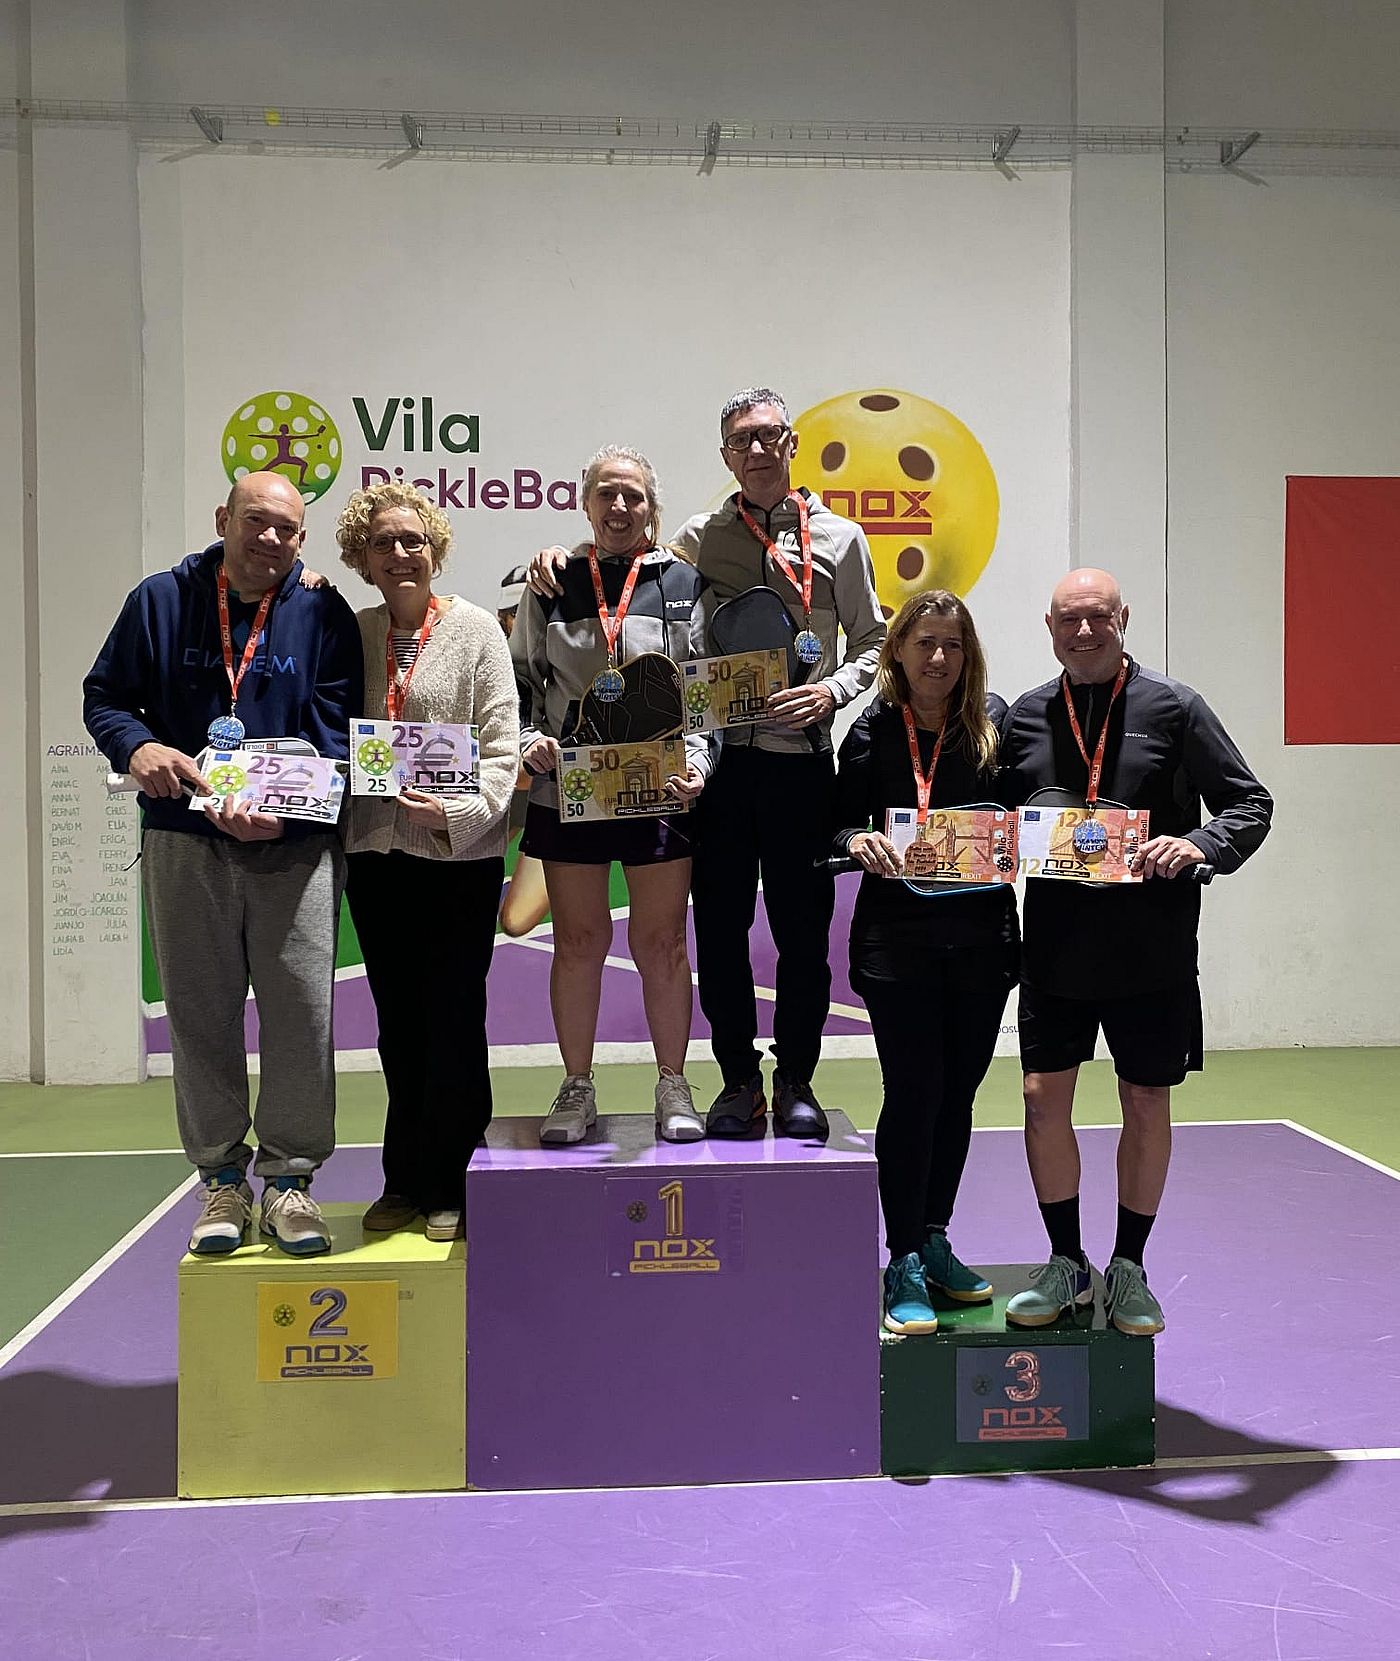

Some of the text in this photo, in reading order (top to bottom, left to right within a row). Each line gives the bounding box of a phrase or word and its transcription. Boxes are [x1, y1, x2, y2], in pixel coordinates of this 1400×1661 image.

[352, 397, 480, 453] Vila
[361, 466, 587, 510] PckleBa
[666, 600, 692, 608] nox
[708, 661, 731, 683] 50
[690, 715, 704, 729] 50
[392, 725, 423, 747] 25
[247, 755, 284, 775] 25
[590, 749, 620, 772] 50
[415, 771, 477, 784] nox
[1091, 764, 1100, 787] nox
[367, 779, 387, 792] 25
[264, 794, 332, 810] nox
[567, 803, 585, 817] 50
[1057, 812, 1078, 827] 12
[998, 838, 1006, 854] Vila
[936, 861, 960, 872] ox
[1020, 858, 1040, 875] 12
[1045, 859, 1088, 871] nox
[658, 1180, 683, 1236] 1
[634, 1239, 716, 1258] nox
[309, 1288, 348, 1337] 2
[286, 1344, 370, 1363] nox
[1004, 1351, 1040, 1402] 3
[983, 1406, 1063, 1426] nox
